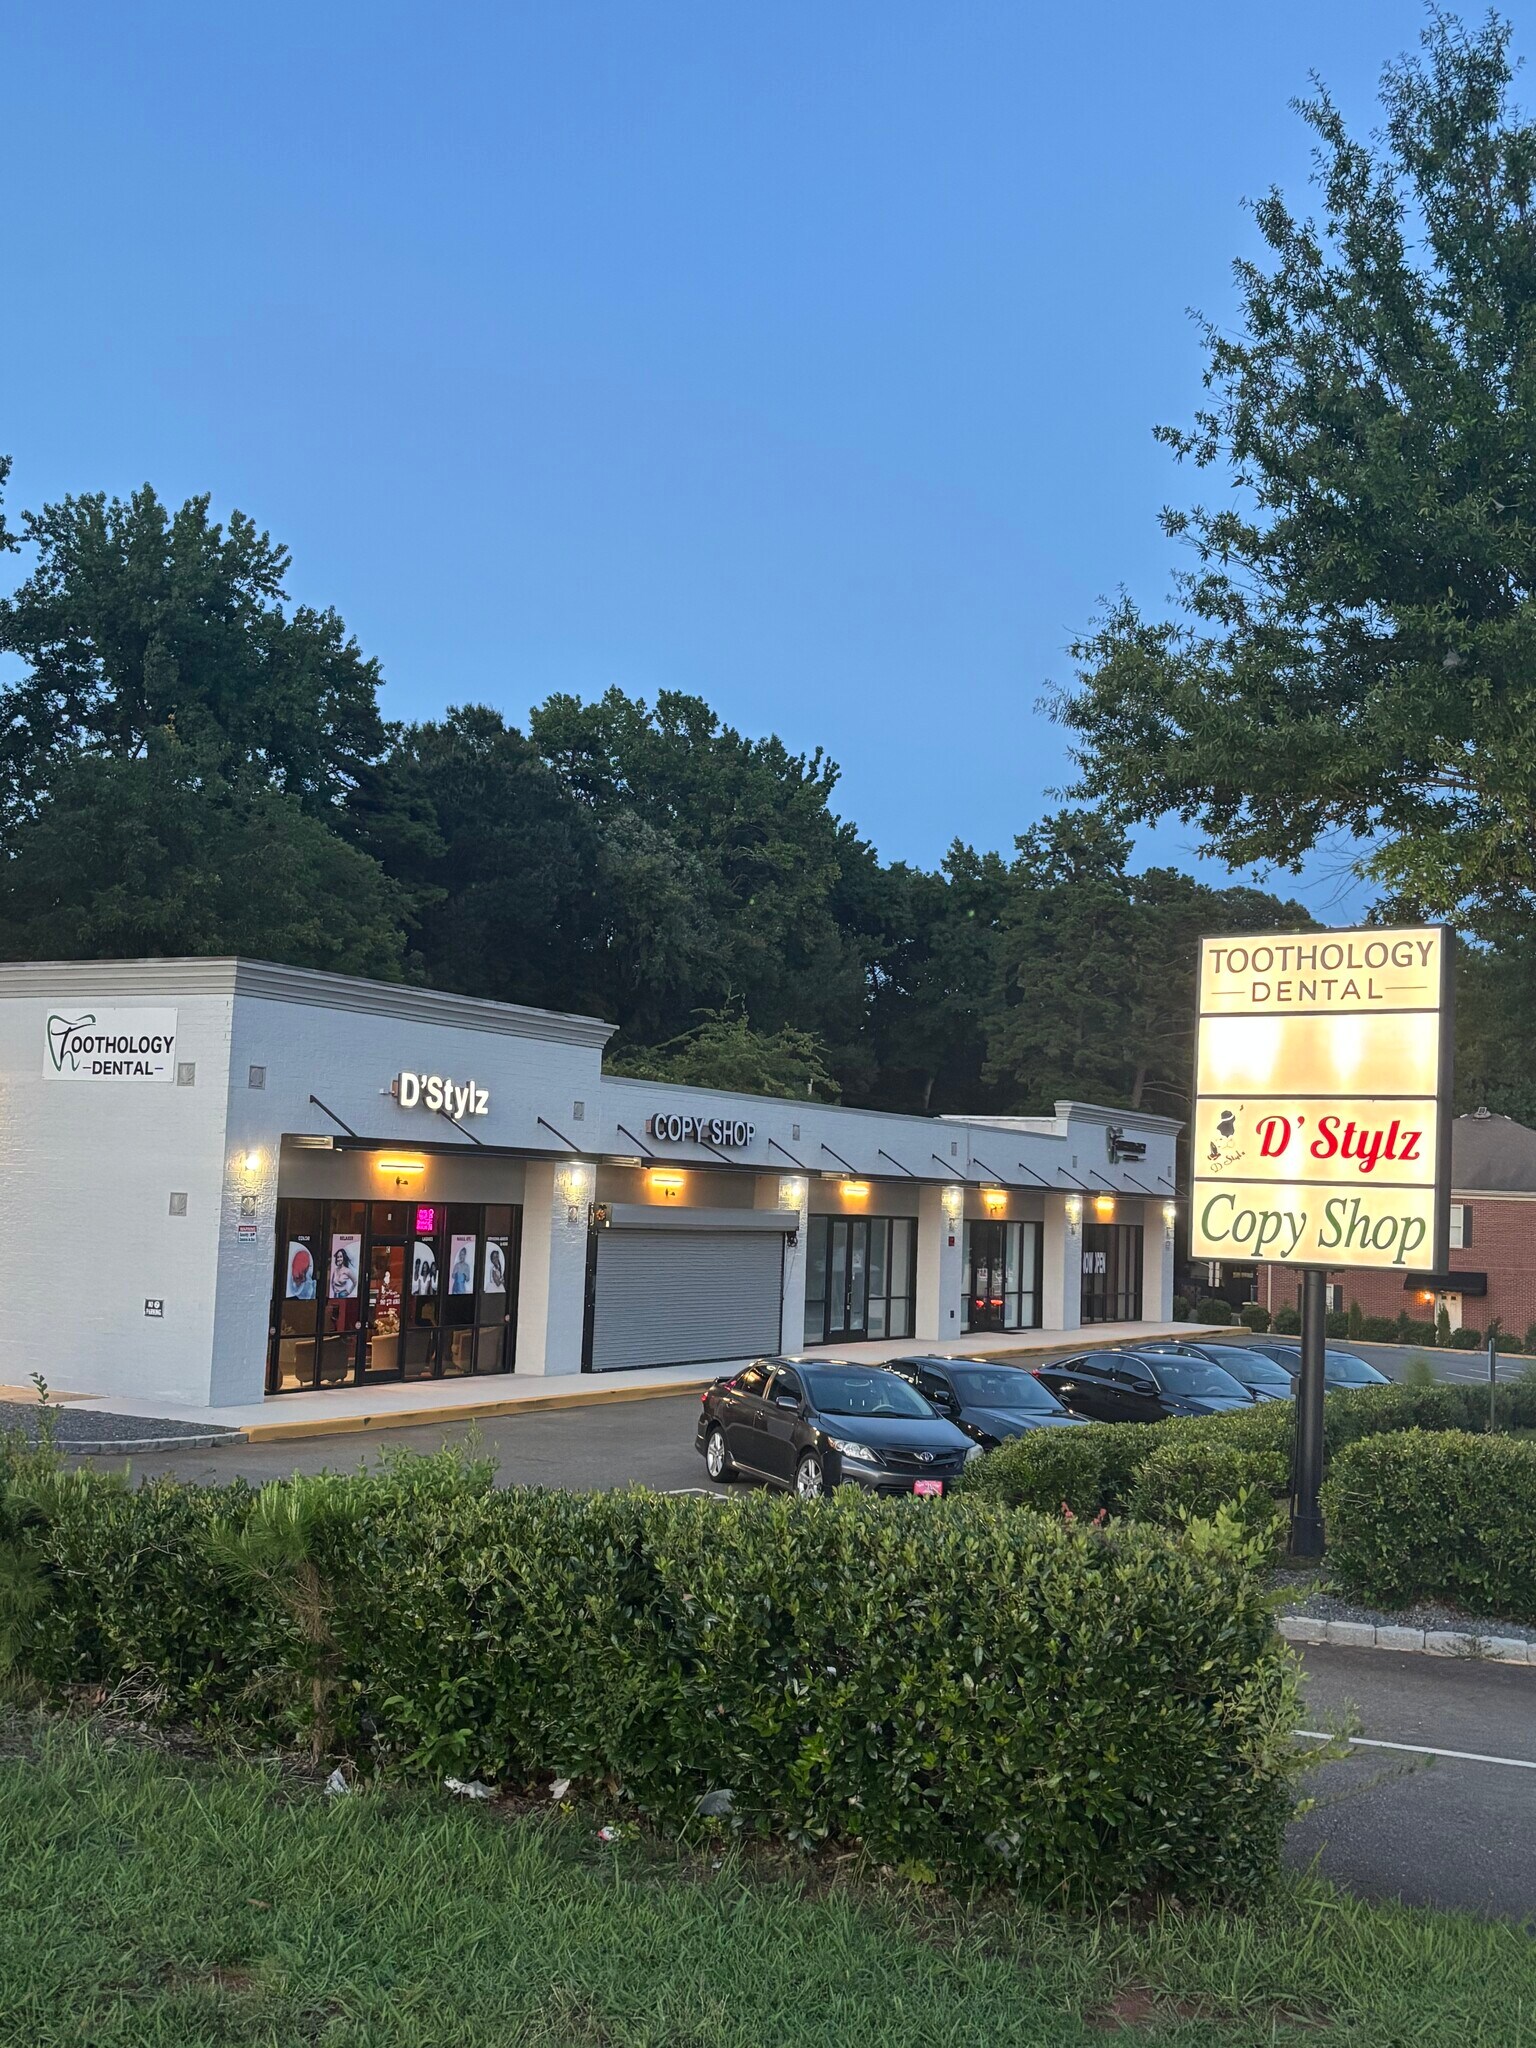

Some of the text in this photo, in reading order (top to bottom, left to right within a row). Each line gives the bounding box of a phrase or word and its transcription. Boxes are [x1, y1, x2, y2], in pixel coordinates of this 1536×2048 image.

[1209, 940, 1434, 974] TOOTHOLOGY
[1252, 978, 1384, 1002] DENTAL
[92, 1061, 154, 1075] DENTAL
[399, 1071, 490, 1119] D'Stylz
[652, 1113, 757, 1146] COPY SHOP
[1201, 1193, 1427, 1265] Copy Shop
